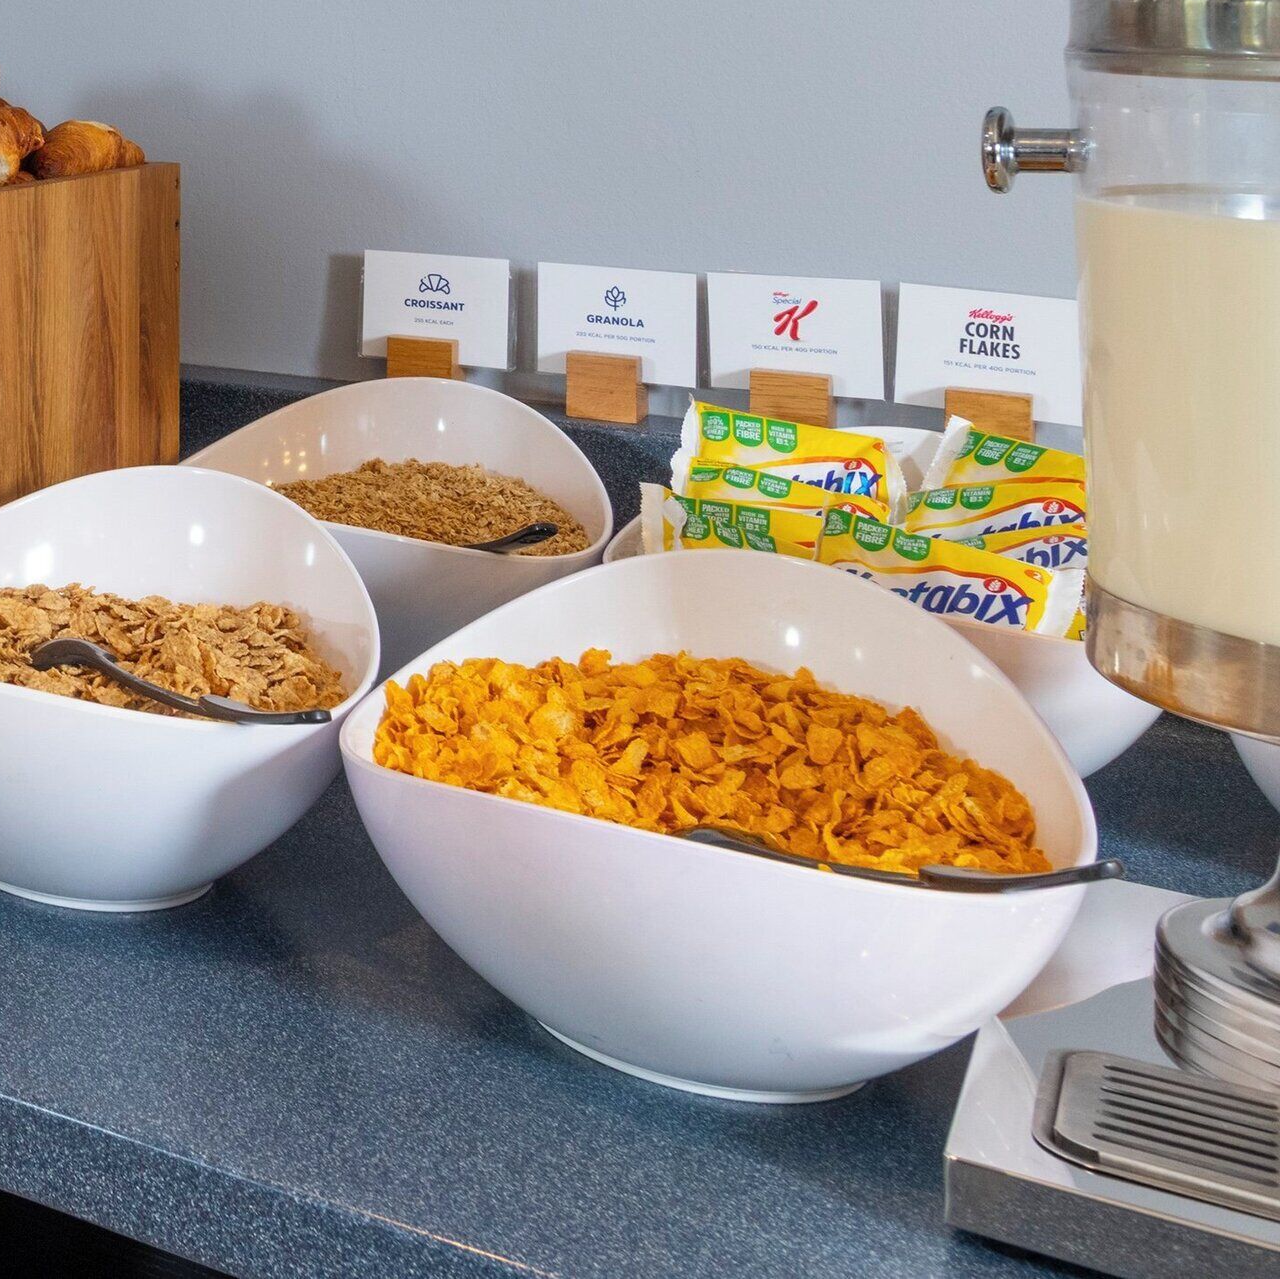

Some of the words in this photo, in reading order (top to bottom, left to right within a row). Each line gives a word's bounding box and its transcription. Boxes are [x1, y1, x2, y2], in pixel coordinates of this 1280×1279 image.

[404, 297, 465, 312] CROISSANT
[772, 296, 802, 305] Special
[586, 314, 644, 328] GRANOLA
[773, 299, 818, 341] K
[968, 308, 1014, 324] Kellogg's
[965, 321, 1014, 341] CORN
[959, 337, 1021, 360] FLAKES
[1005, 367, 1036, 376] PORTION
[736, 429, 761, 441] FIBRE
[855, 532, 886, 546] FIBRE
[845, 569, 1035, 625] tabix
